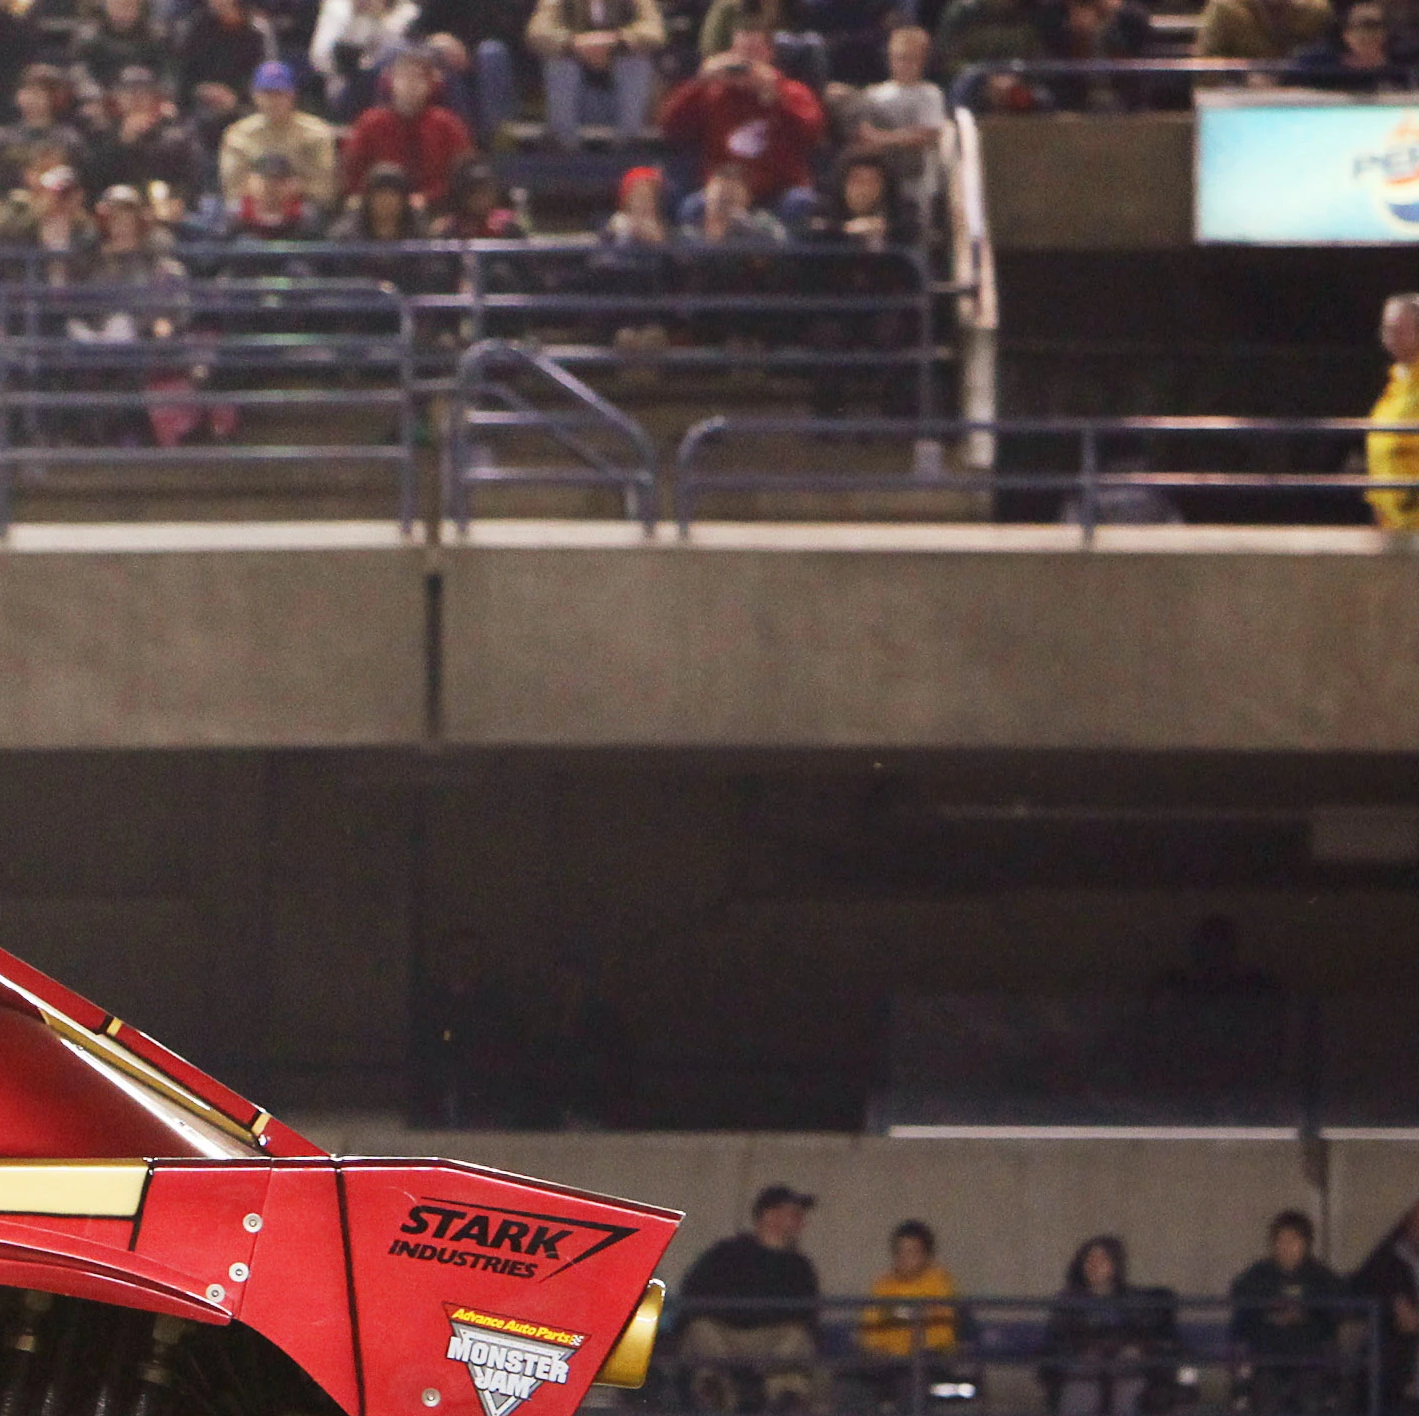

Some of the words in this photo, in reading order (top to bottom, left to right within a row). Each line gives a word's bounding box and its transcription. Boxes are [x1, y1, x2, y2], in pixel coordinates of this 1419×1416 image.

[400, 1205, 573, 1260] STARK
[388, 1239, 539, 1279] INDUSTRIES
[452, 1308, 505, 1329] Advance
[503, 1320, 537, 1337] Auto
[536, 1326, 575, 1344] Parts
[446, 1336, 570, 1384] MONSTER
[474, 1364, 538, 1399] JAM
